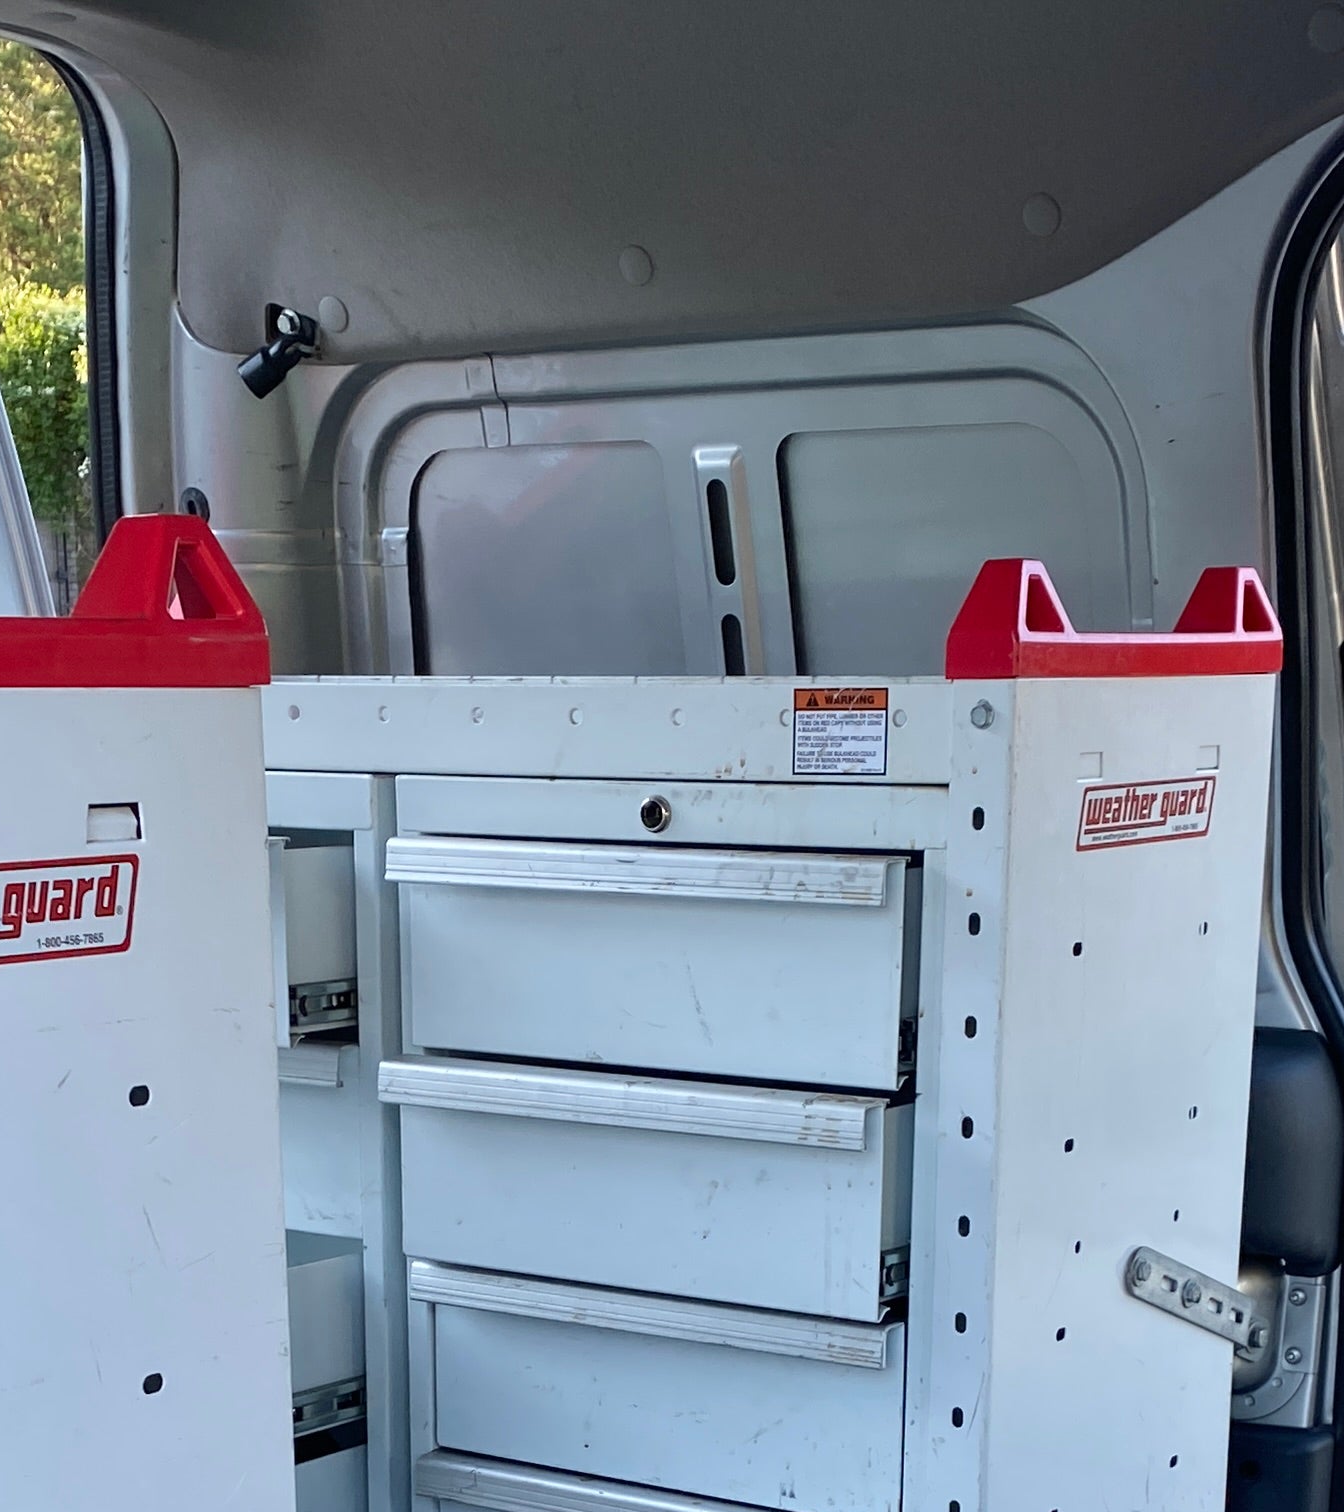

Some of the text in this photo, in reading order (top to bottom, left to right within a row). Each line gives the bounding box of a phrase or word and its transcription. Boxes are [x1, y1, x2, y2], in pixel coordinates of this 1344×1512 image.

[824, 695, 875, 705] WARNING
[1085, 781, 1208, 826] weather guard
[2, 865, 119, 937] guard
